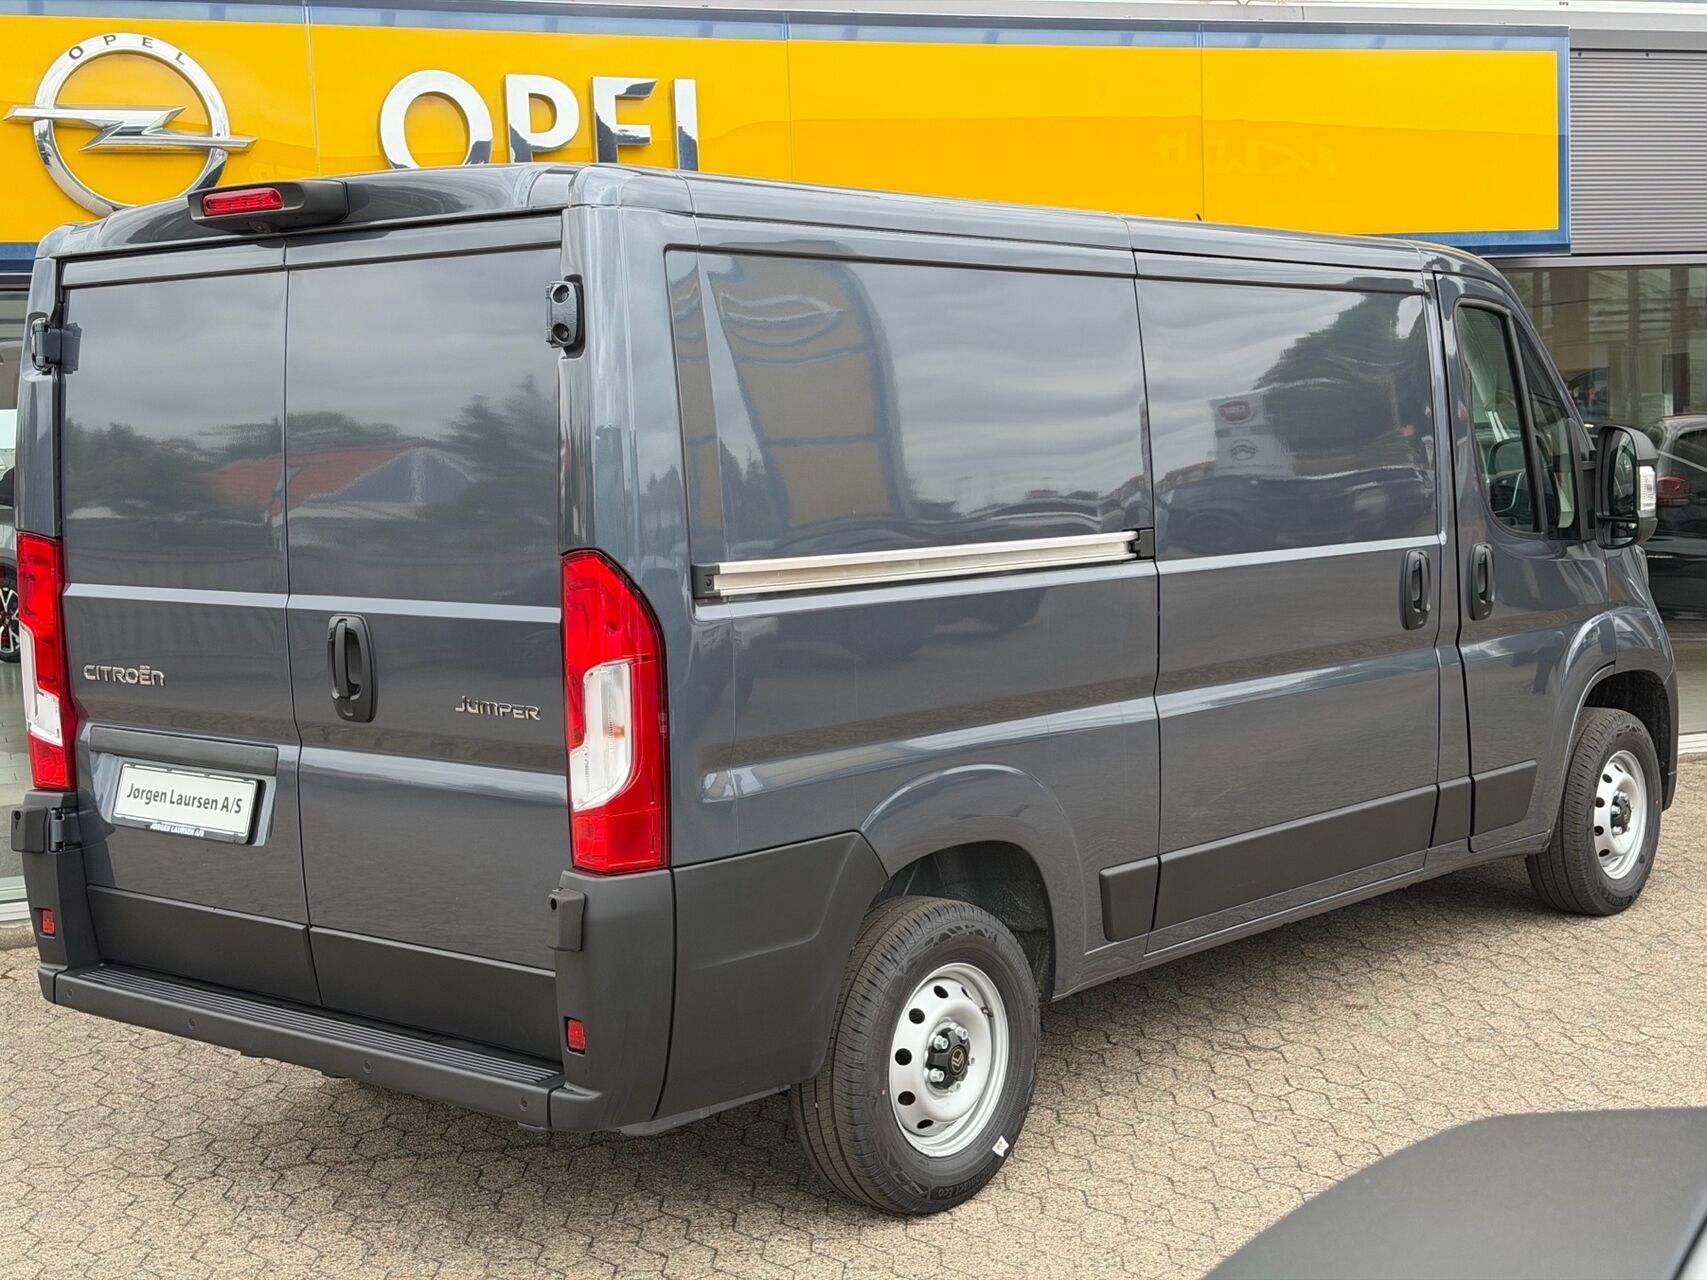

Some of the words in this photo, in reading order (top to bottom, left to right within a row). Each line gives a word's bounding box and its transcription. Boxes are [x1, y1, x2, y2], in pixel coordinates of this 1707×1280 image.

[68, 34, 185, 66] OPEL
[126, 783, 167, 806] Jørgen
[169, 788, 218, 811] Laursen
[220, 796, 243, 814] A/S
